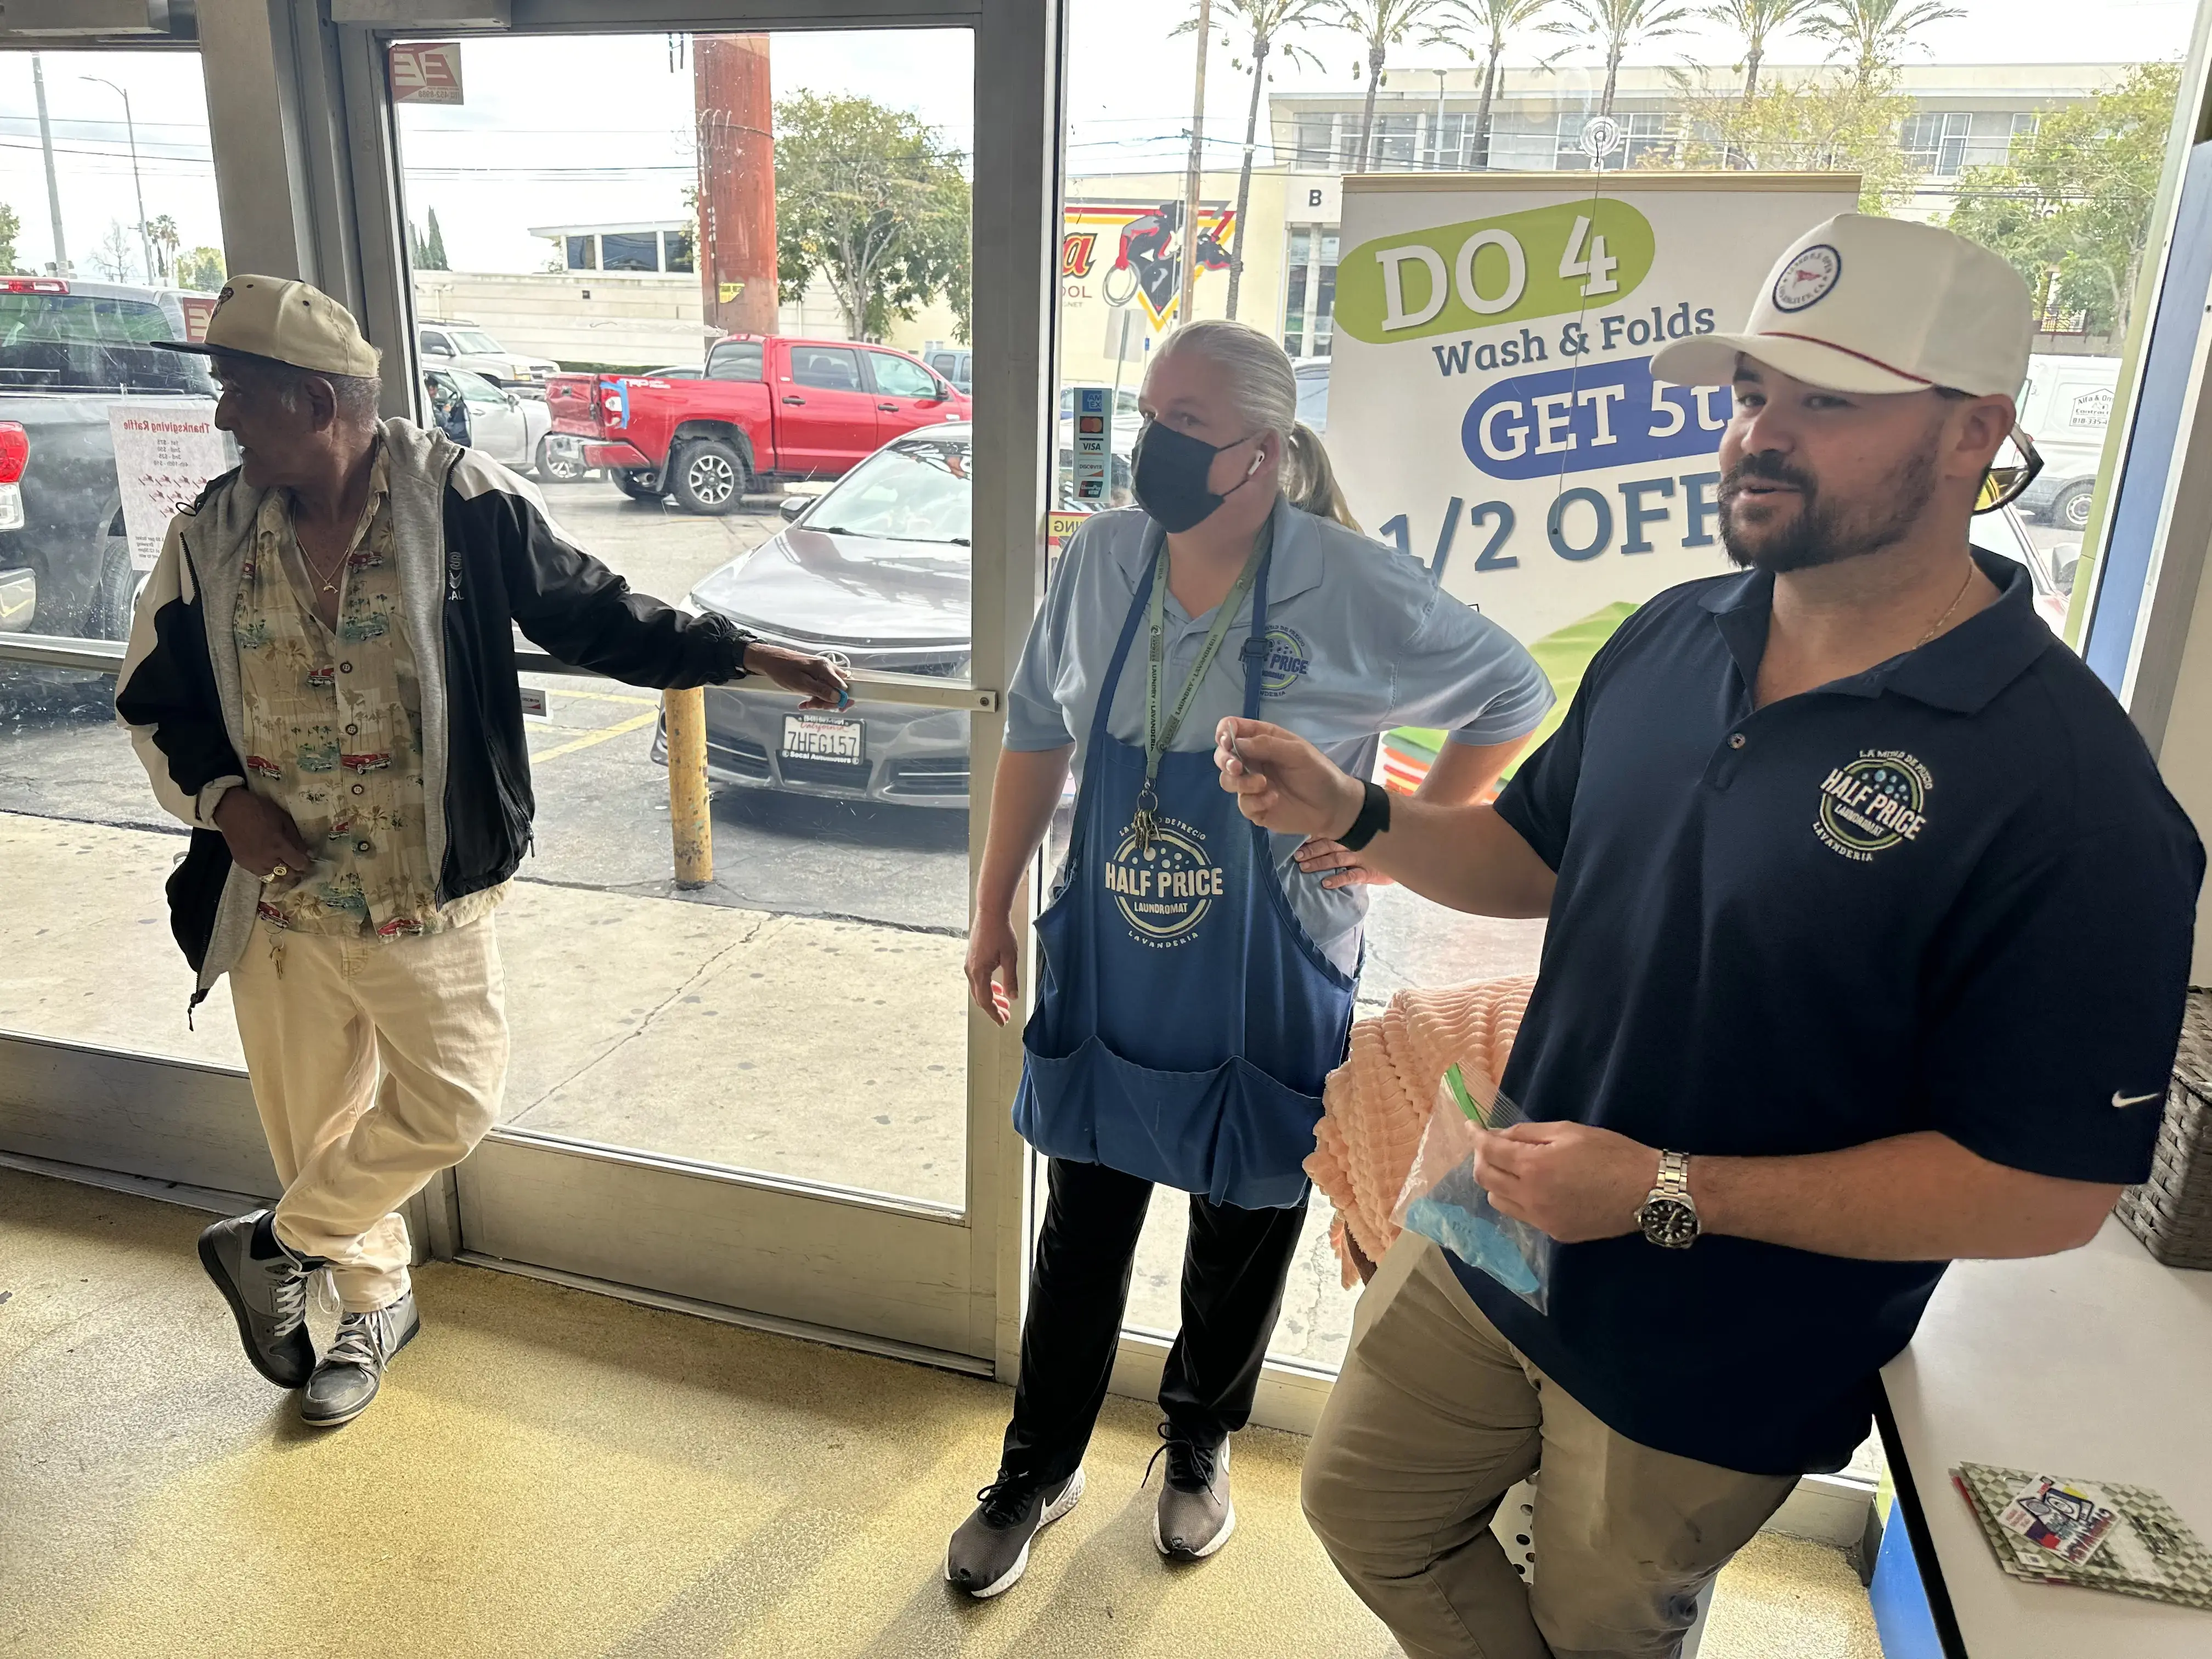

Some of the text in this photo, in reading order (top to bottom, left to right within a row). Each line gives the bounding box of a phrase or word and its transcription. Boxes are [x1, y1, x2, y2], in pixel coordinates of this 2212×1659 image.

[1308, 189, 1322, 207] B
[1375, 216, 1618, 331] DO 4
[1432, 302, 1716, 376] Wash & Folds
[1479, 380, 1734, 461] GET 5t
[1379, 496, 1517, 581] 1/2
[1175, 634, 1218, 715] LAUNDRY LAVANDERIA
[1269, 653, 1309, 674] PRICE
[1859, 749, 1875, 758] LA
[1820, 768, 1927, 840] HALF PRICE
[1834, 804, 1884, 837] LAUNDROMAT
[1119, 826, 1130, 837] LA
[1165, 817, 1176, 825] DE
[1177, 820, 1206, 840] PRECIO
[1812, 821, 1873, 861] LAVANDERIA
[1105, 861, 1223, 898] HALF PRICE
[1134, 901, 1188, 915] LAUNDROMAT
[1128, 930, 1199, 949] LAVANDERIA
